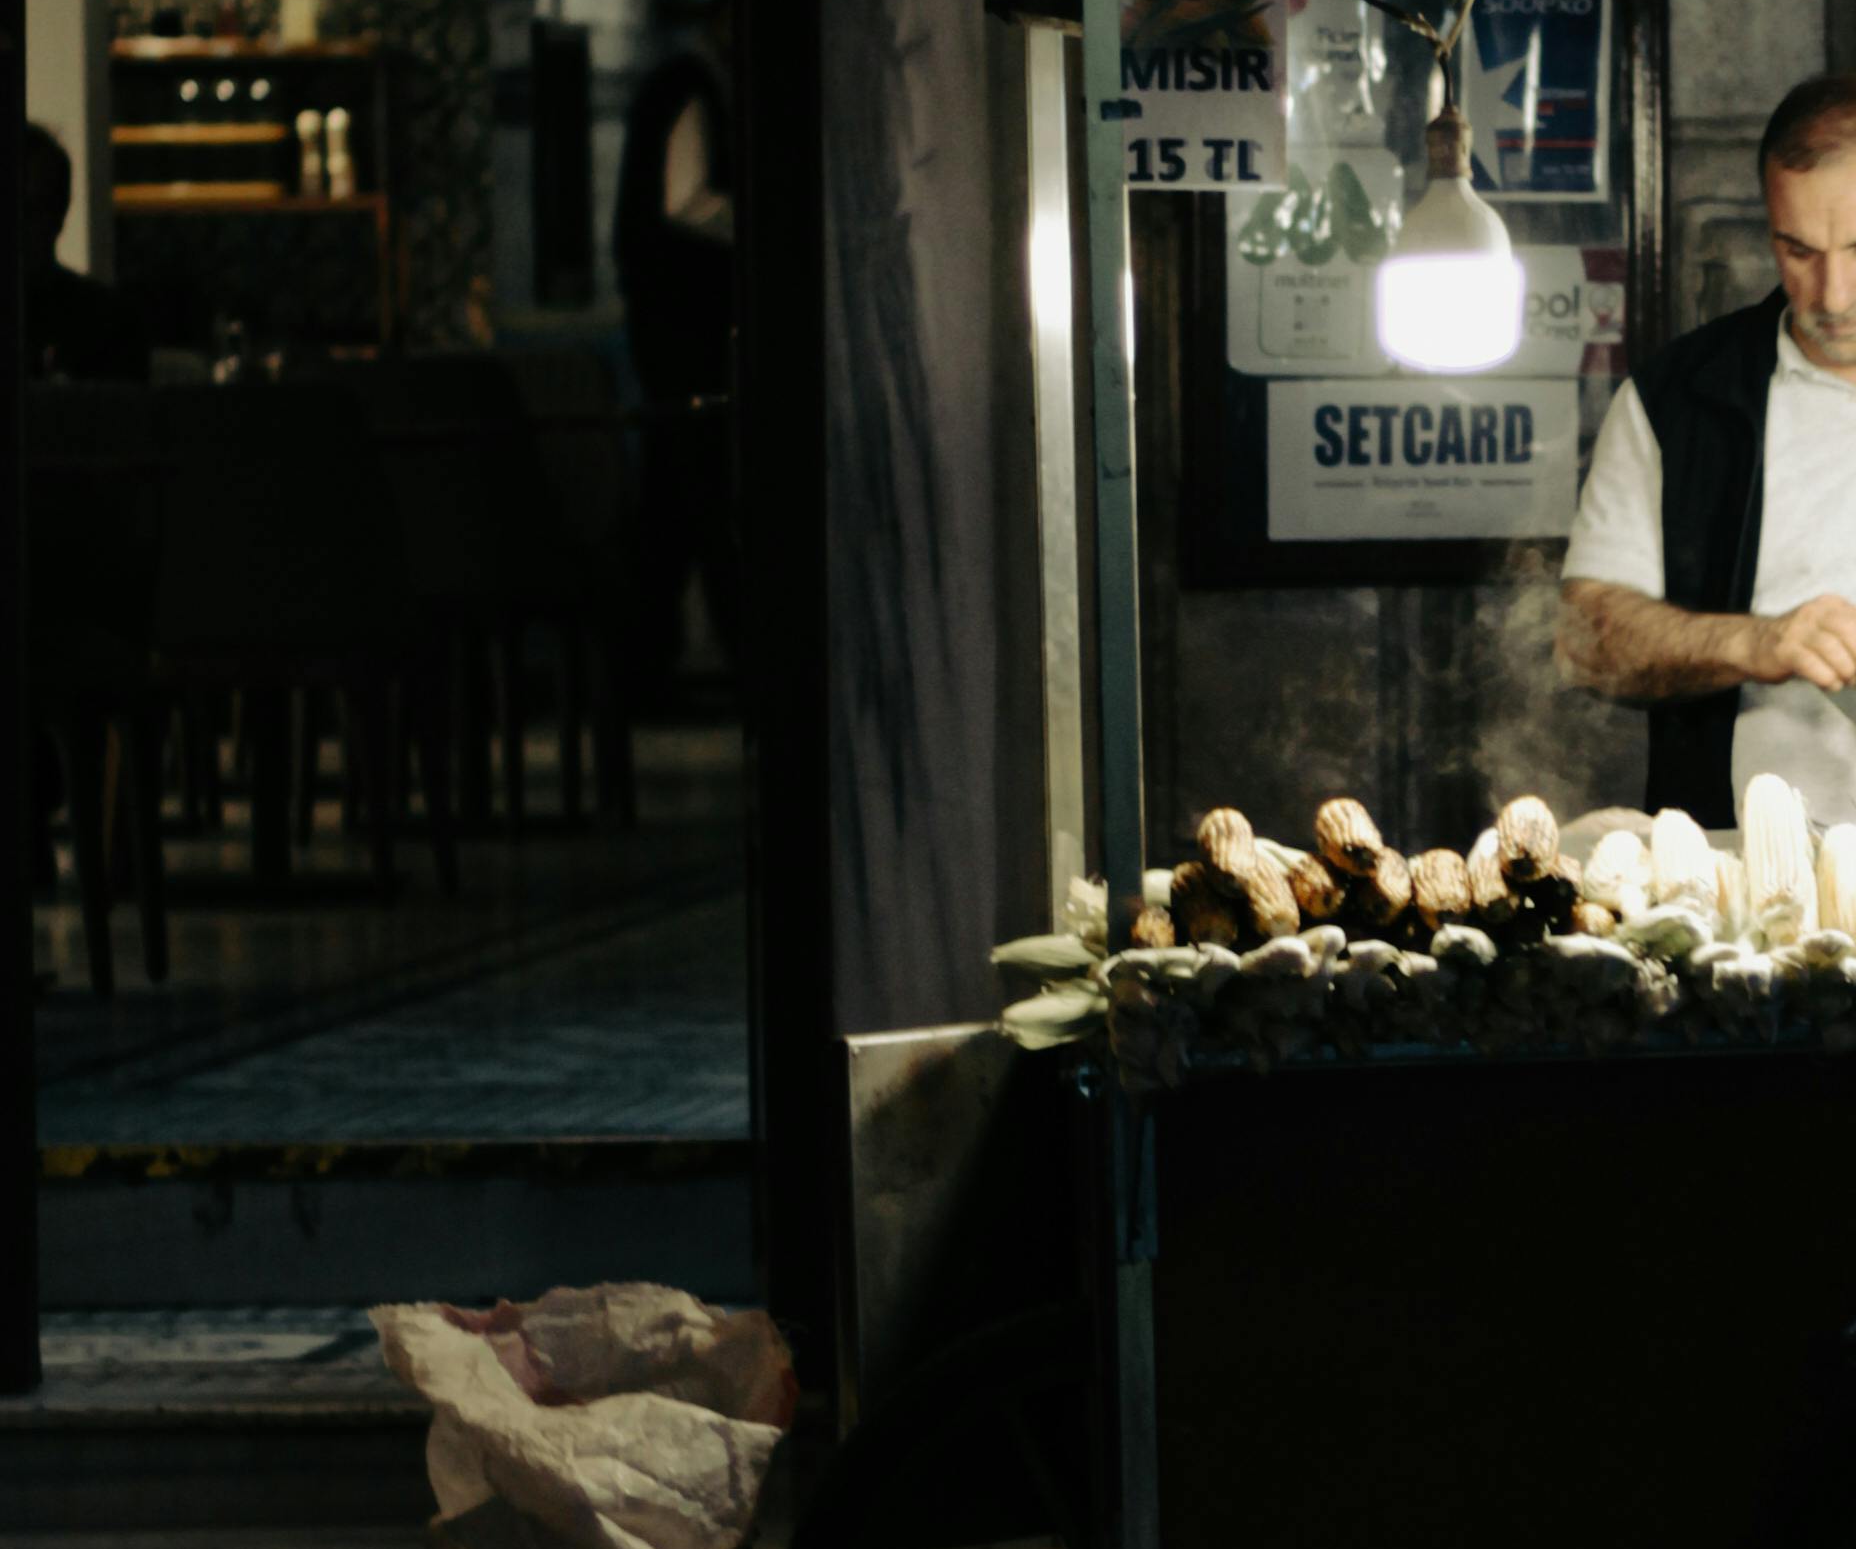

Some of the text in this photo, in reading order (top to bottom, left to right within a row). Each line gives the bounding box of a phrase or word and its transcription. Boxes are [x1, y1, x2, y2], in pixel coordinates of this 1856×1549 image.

[1120, 46, 1272, 92] MISIR
[1127, 138, 1262, 182] 15 TL
[1313, 403, 1535, 468] SETCARD
